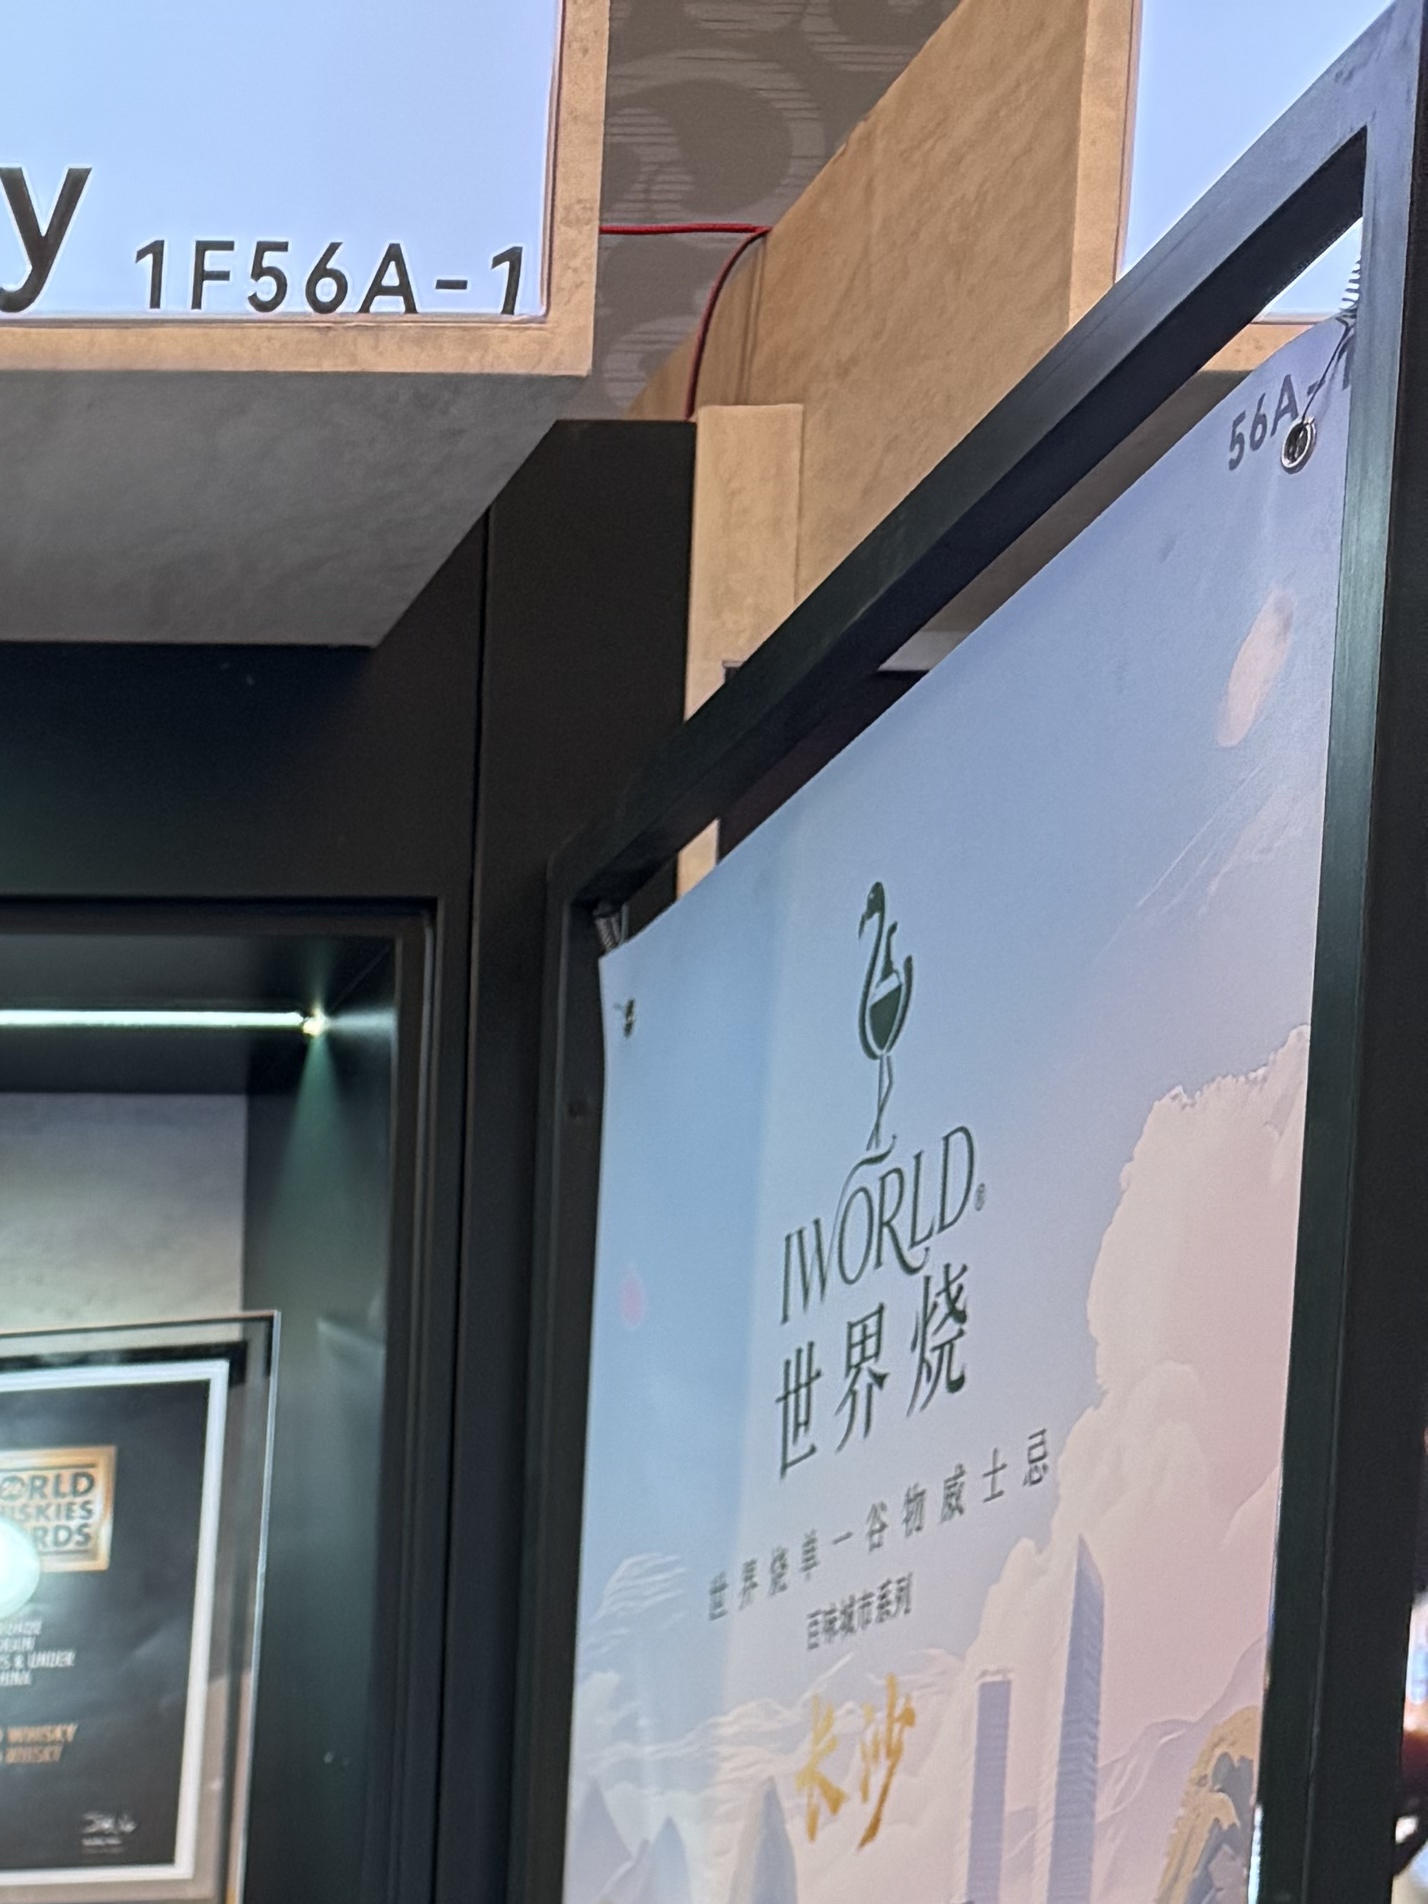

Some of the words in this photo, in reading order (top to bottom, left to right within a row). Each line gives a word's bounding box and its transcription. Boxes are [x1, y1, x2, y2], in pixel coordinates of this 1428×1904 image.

[135, 240, 526, 316] 1F56A-1
[779, 1125, 979, 1327] IWORLD
[776, 1261, 968, 1482] 世界烧
